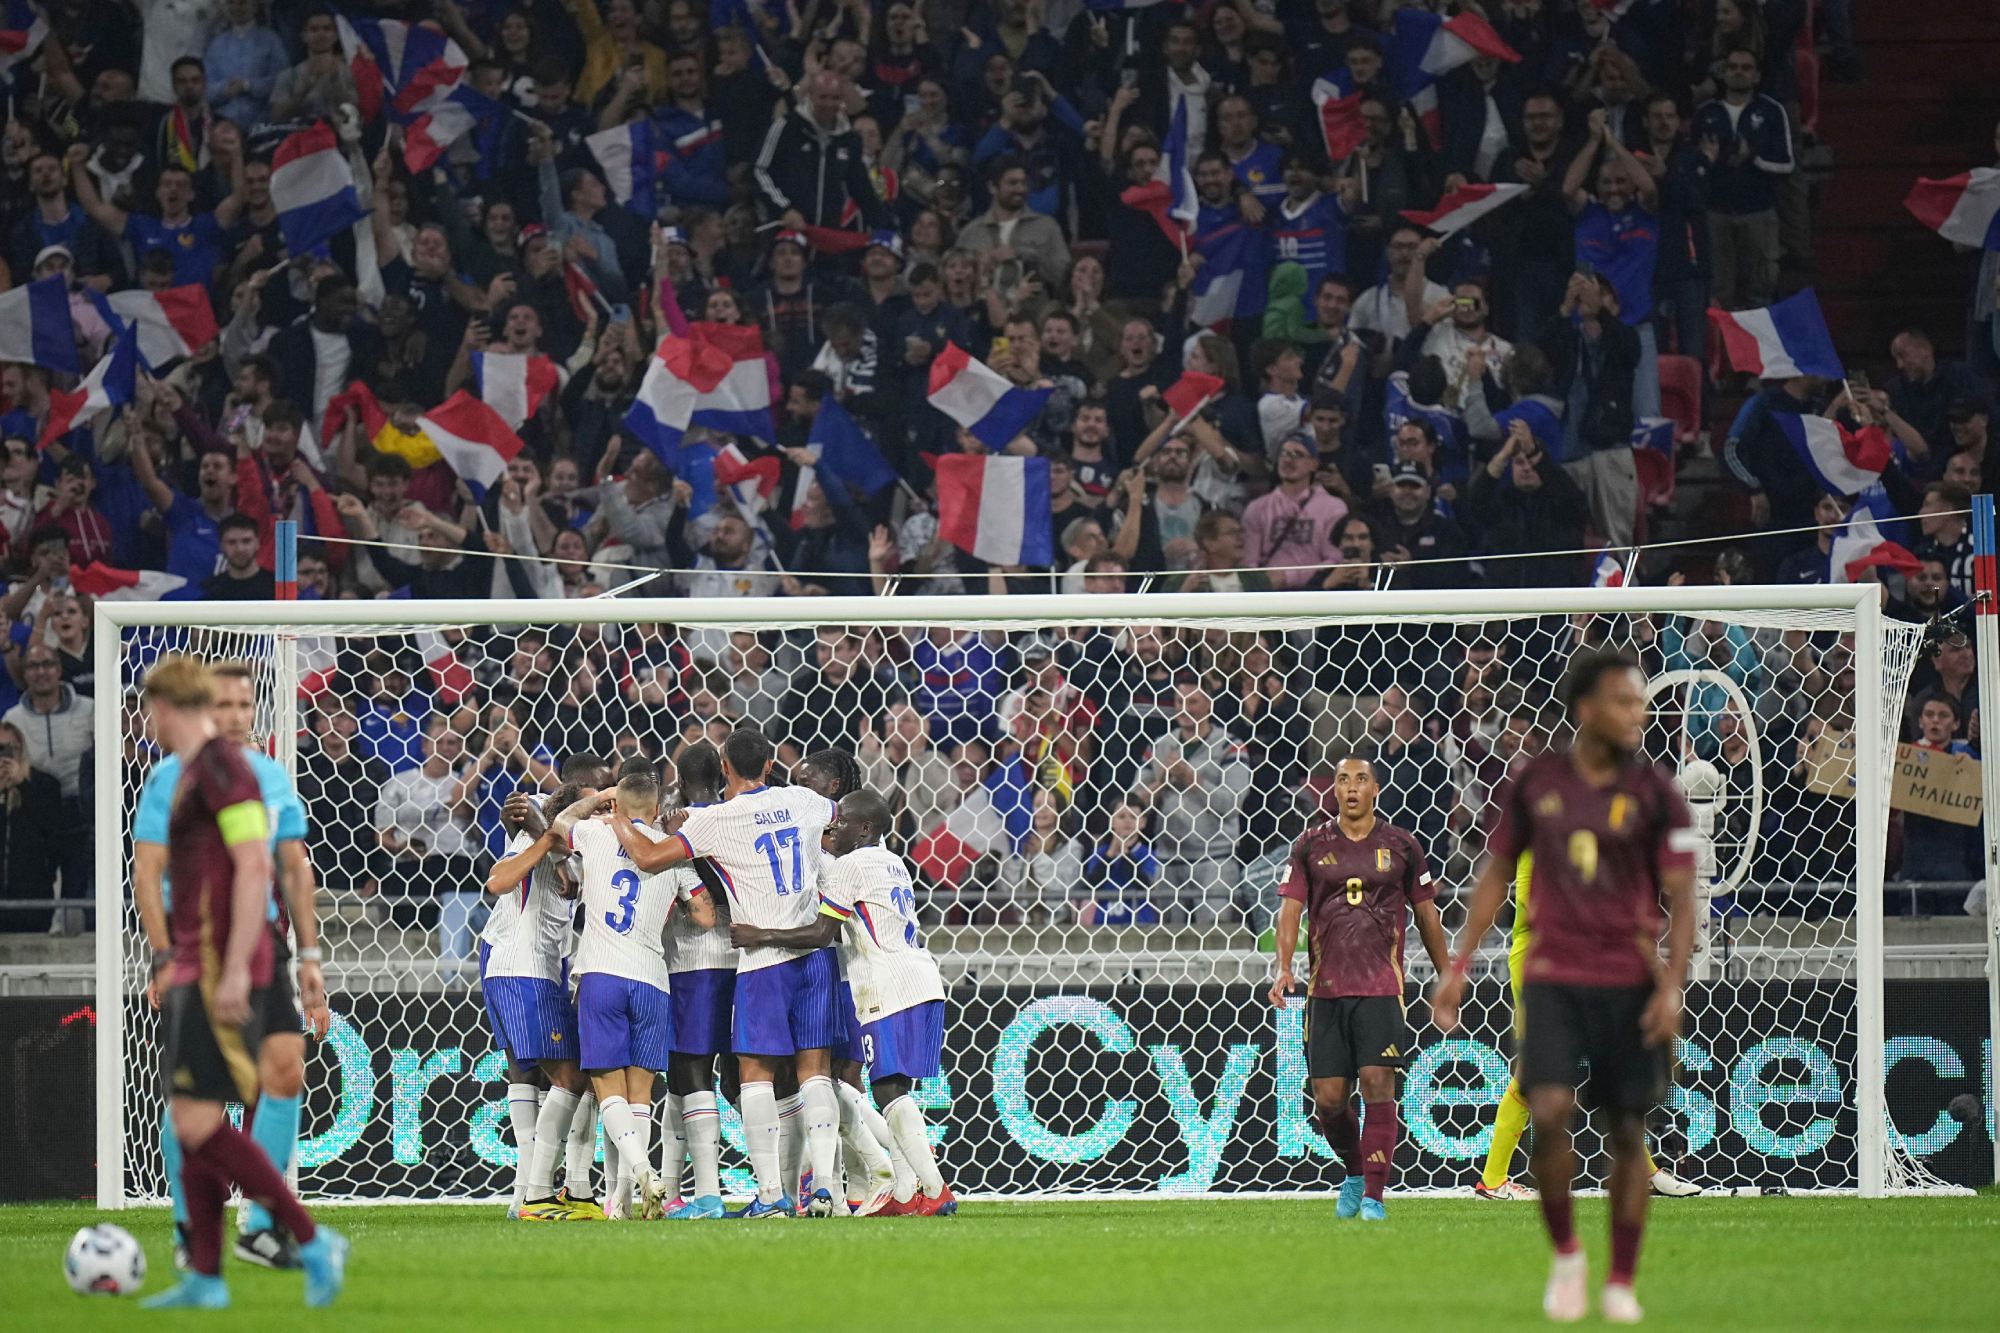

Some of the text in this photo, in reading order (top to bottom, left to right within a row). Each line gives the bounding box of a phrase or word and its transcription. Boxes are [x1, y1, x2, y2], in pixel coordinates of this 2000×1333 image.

[754, 808, 792, 825] SALIBA
[754, 826, 804, 896] 17
[1567, 828, 1600, 886] 9
[604, 868, 642, 936] 3
[1346, 877, 1363, 906] 8
